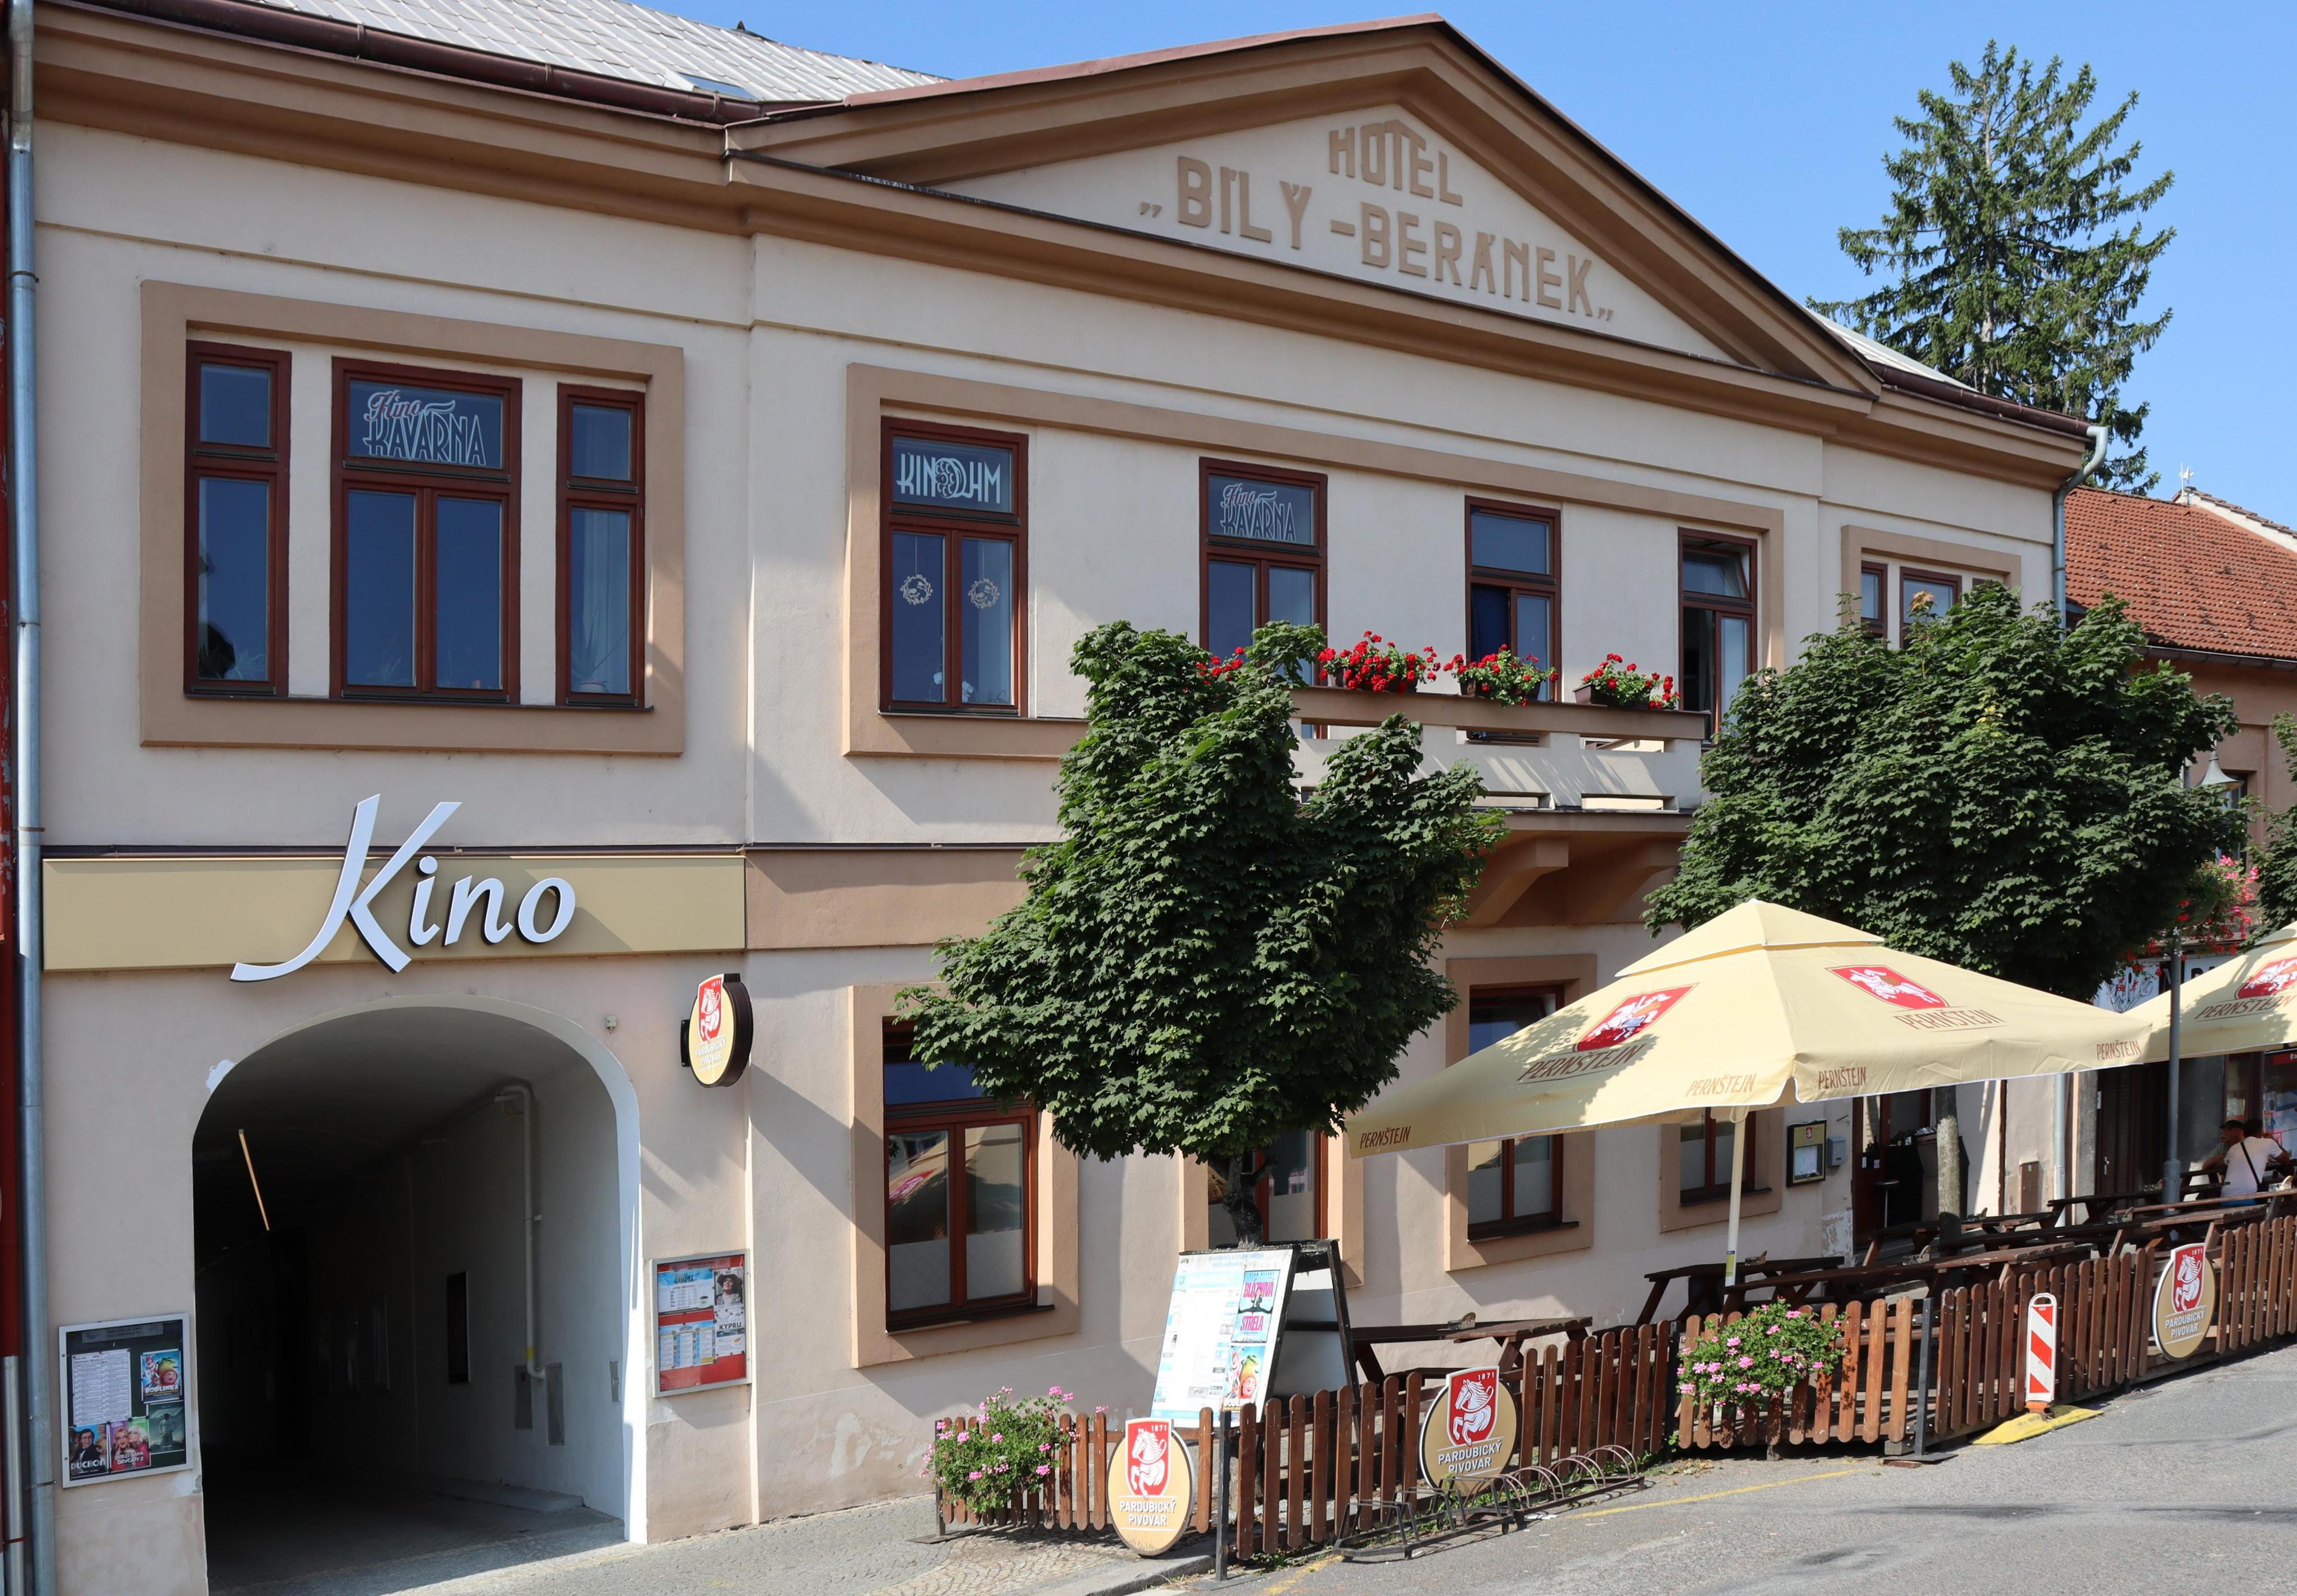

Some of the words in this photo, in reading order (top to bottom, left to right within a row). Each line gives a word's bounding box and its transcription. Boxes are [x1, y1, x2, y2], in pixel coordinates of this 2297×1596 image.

[1329, 119, 1463, 207] HOTEL
[230, 794, 575, 983] Kino
[2194, 995, 2297, 1019] PERNŠTEJN
[1893, 1009, 2005, 1030] PERNŠTEJN
[695, 1037, 727, 1058] PARDUBICKÝ
[2096, 1039, 2141, 1060] PERNŠTEJN
[700, 1052, 722, 1066] PIVOVAR
[1516, 1043, 1647, 1081] PERNŠTEJN
[1685, 1073, 1757, 1097] PERNŠTEJN
[1818, 1066, 1867, 1090] PERNŠTEJN
[1360, 1126, 1412, 1149] PERNŠTEJN
[719, 1321, 742, 1330] KYPRU
[2164, 1308, 2206, 1330] PARDUBICKÝ
[2171, 1323, 2199, 1339] PIVOVAR
[1478, 1372, 1495, 1381] 1871
[1438, 1440, 1502, 1466] PARDUBICKÝ
[1448, 1456, 1492, 1474] PIVOVAR
[1120, 1499, 1177, 1513] PARDUBICKÝ
[1128, 1514, 1167, 1527] PIVOVAR
